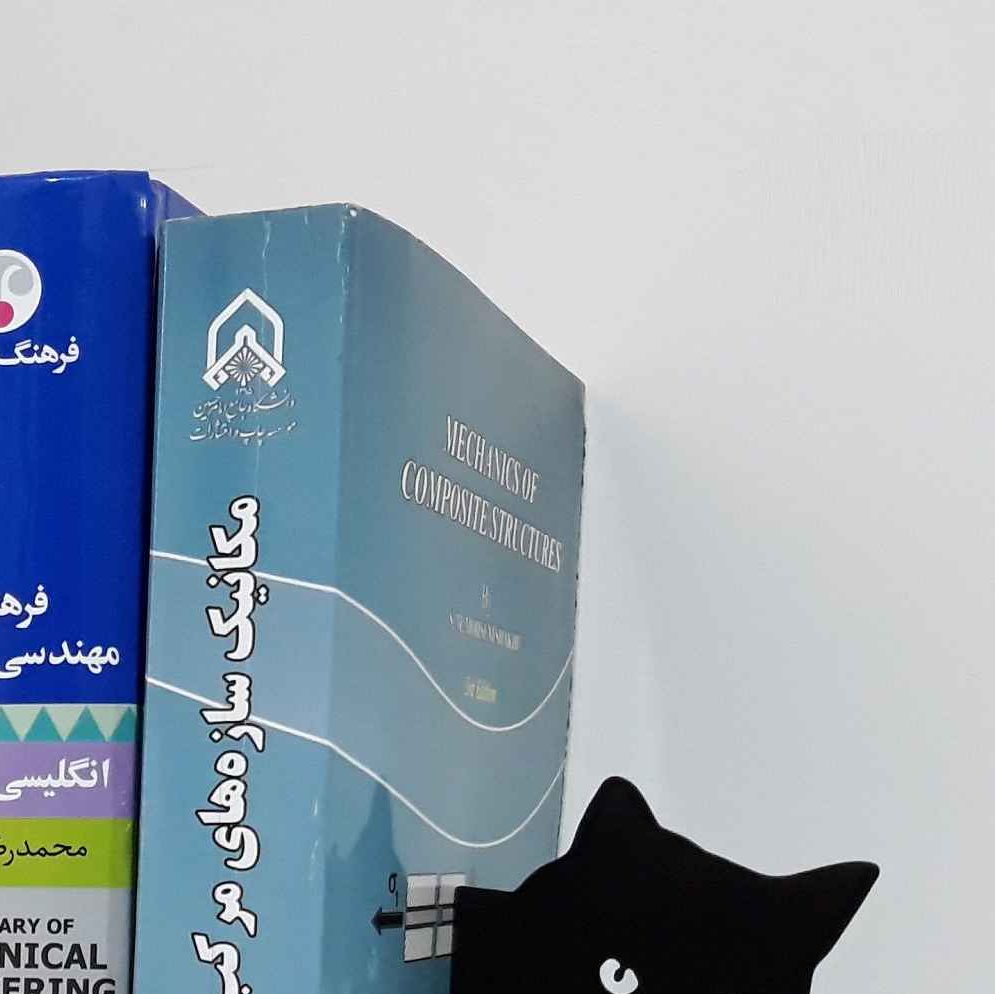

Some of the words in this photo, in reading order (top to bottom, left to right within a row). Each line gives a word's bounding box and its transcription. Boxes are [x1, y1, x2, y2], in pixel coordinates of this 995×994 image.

[445, 415, 521, 496] MECHANICS
[521, 467, 540, 504] OF
[401, 459, 490, 536] COMPOSITE
[489, 505, 562, 573] STRUCTURES
[203, 496, 269, 663] مکانیک
[46, 918, 75, 935] OF
